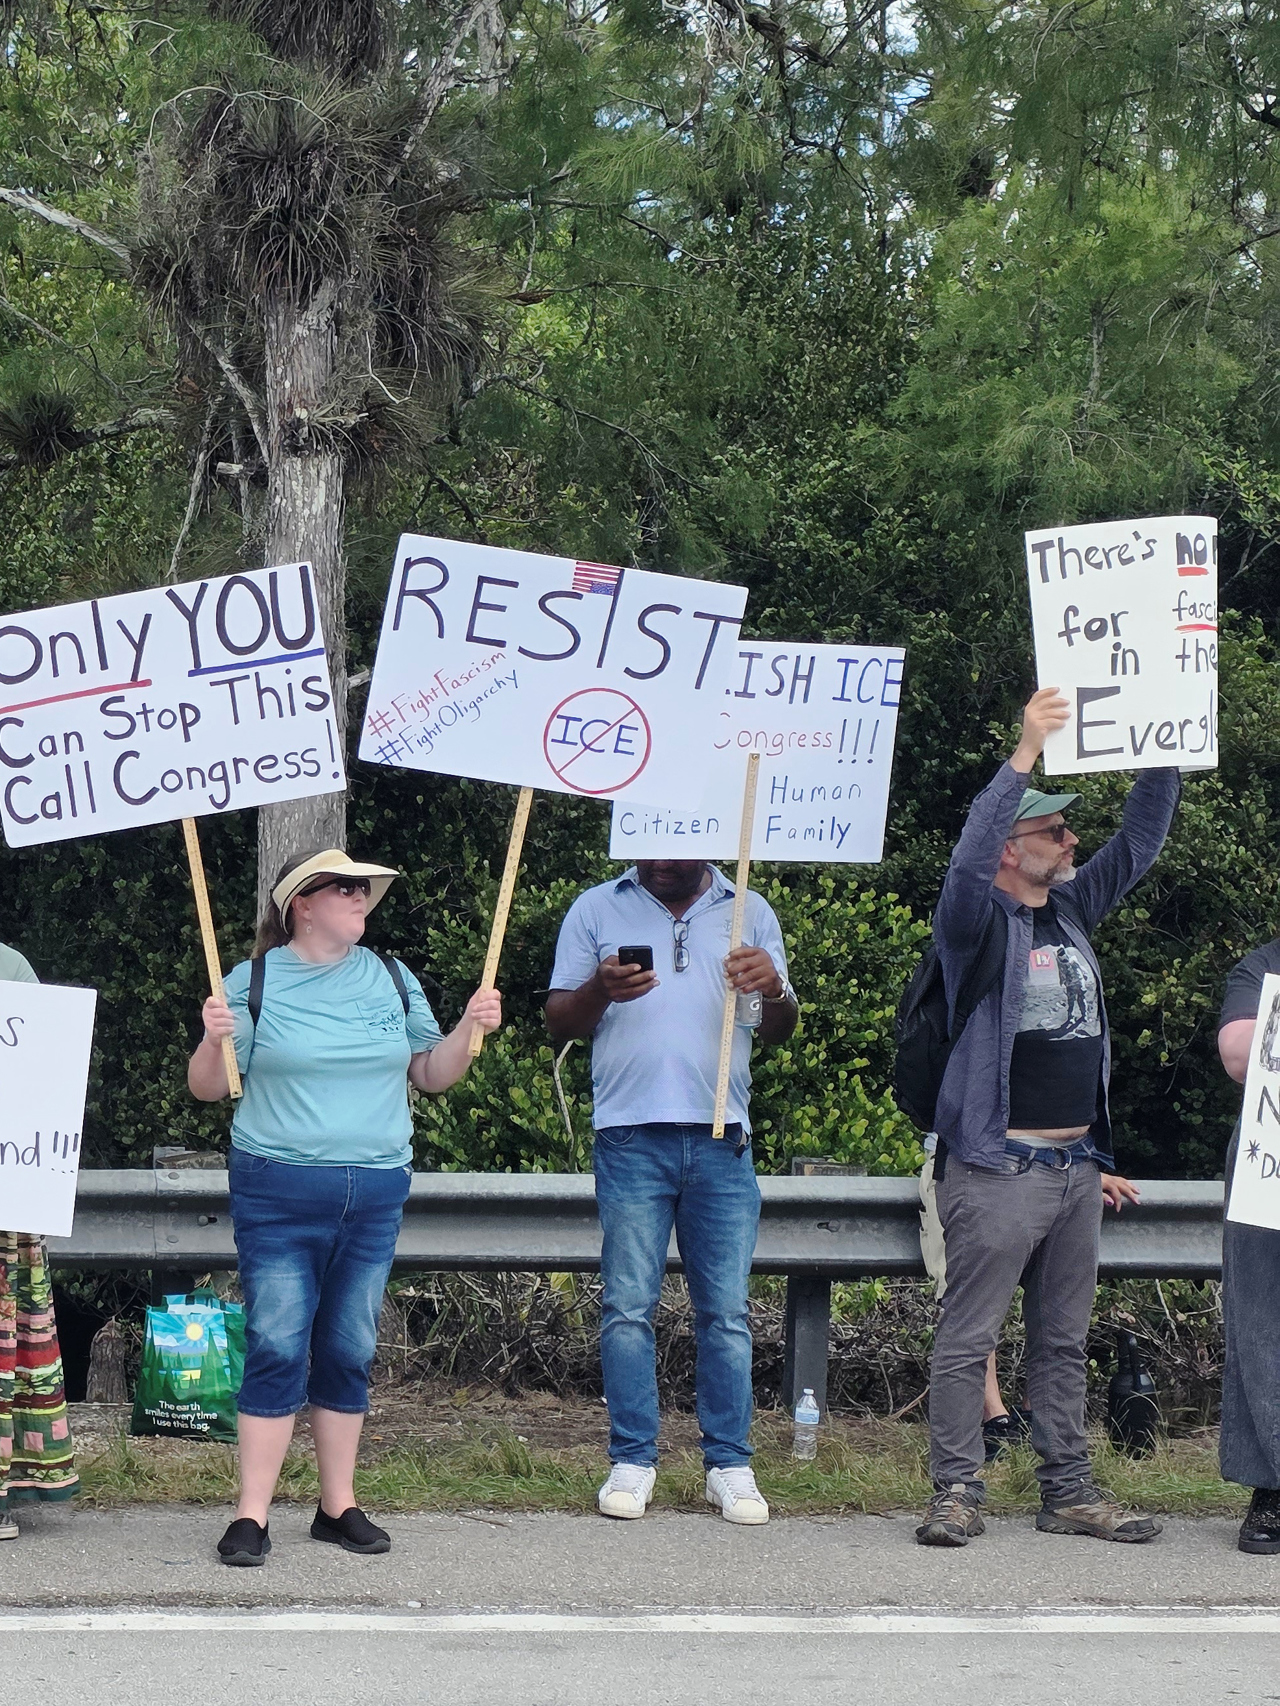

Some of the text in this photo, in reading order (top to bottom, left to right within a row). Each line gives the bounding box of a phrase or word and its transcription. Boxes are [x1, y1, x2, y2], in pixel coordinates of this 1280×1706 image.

[1031, 531, 1157, 583] There's
[1175, 532, 1208, 566] no
[165, 565, 316, 669] YOU
[393, 556, 742, 690] RESIST
[1058, 605, 1129, 647] for
[725, 652, 904, 707] ISH ICE
[1110, 638, 1218, 676] in the
[100, 696, 202, 742] Stop
[210, 668, 330, 725] This
[368, 652, 507, 738] #FightFascism
[374, 669, 519, 765] #FightOligarchy
[551, 714, 639, 755] ICE
[1076, 686, 1218, 760] Evergl
[5, 719, 340, 824] Call Congress!
[771, 776, 862, 804] Human
[620, 811, 719, 835] Citizen
[766, 815, 851, 849] Family
[144, 1408, 218, 1422] smiles every time
[157, 1419, 172, 1428] use
[173, 1420, 189, 1429] this
[159, 1400, 201, 1411] The earth
